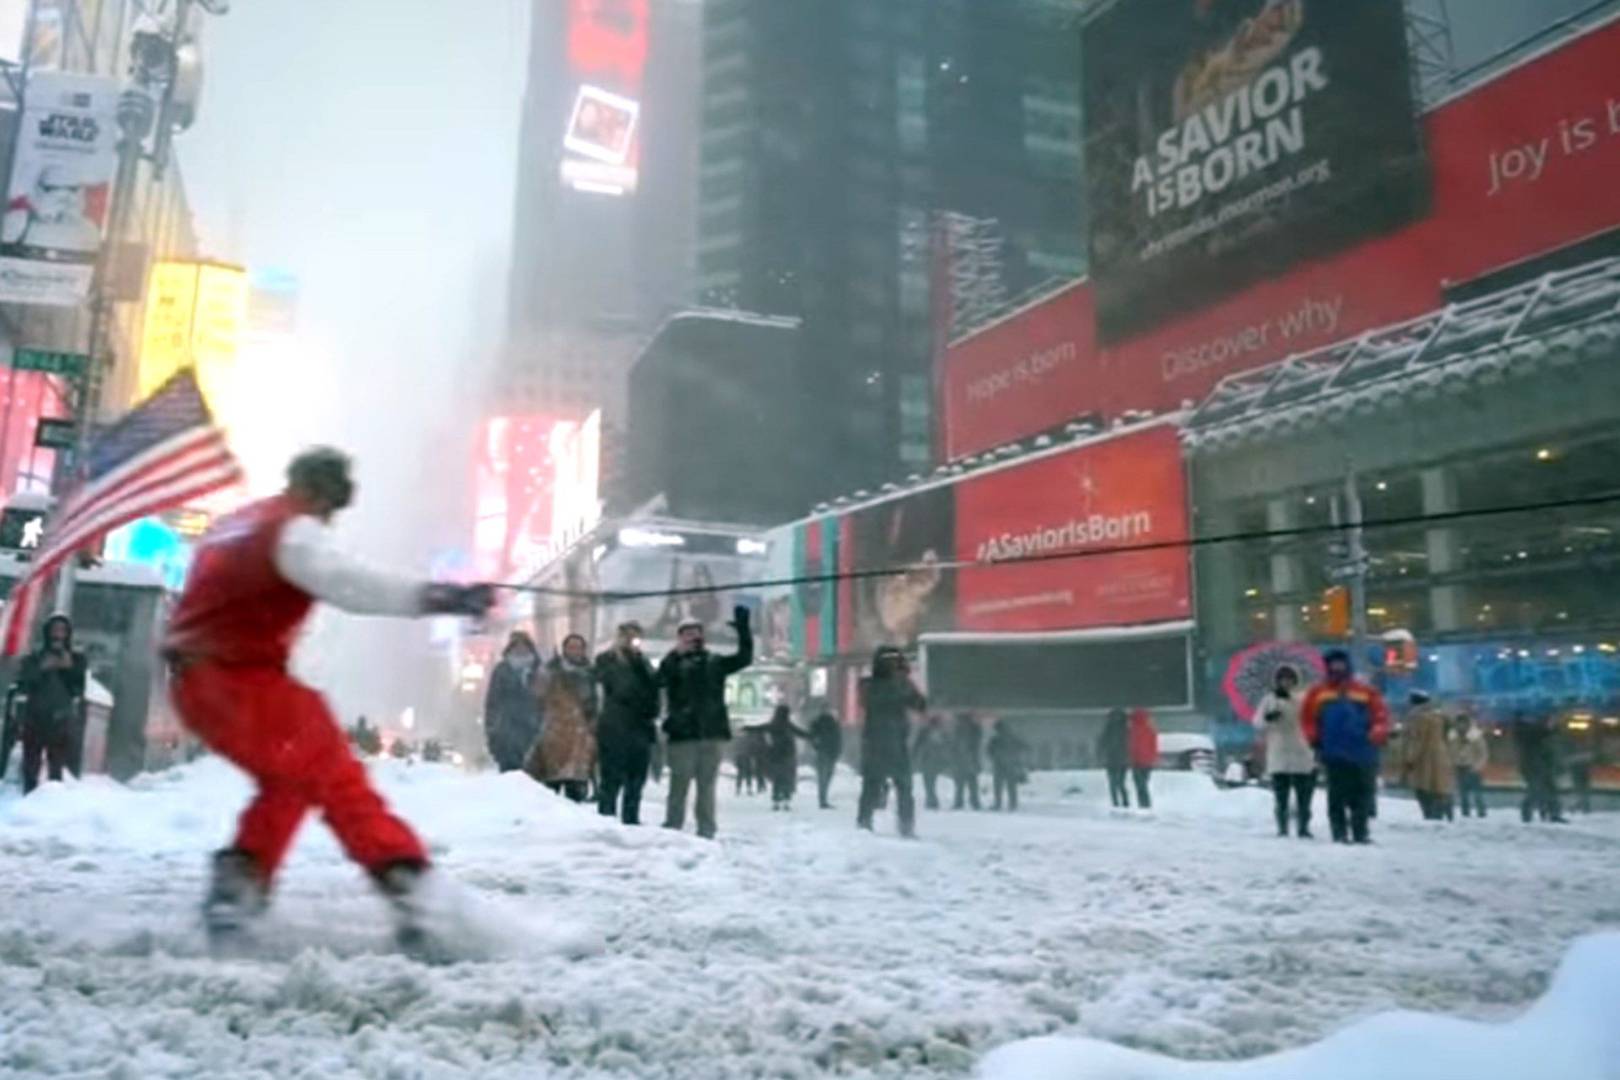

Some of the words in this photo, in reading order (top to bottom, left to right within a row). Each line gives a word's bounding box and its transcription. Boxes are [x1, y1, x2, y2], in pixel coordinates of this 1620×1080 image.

[1131, 156, 1154, 193] A
[1156, 47, 1329, 175] SAVIOR
[1487, 137, 1549, 197] Joy
[1558, 118, 1597, 155] is
[1161, 320, 1274, 382] Discover
[1279, 294, 1344, 339] why
